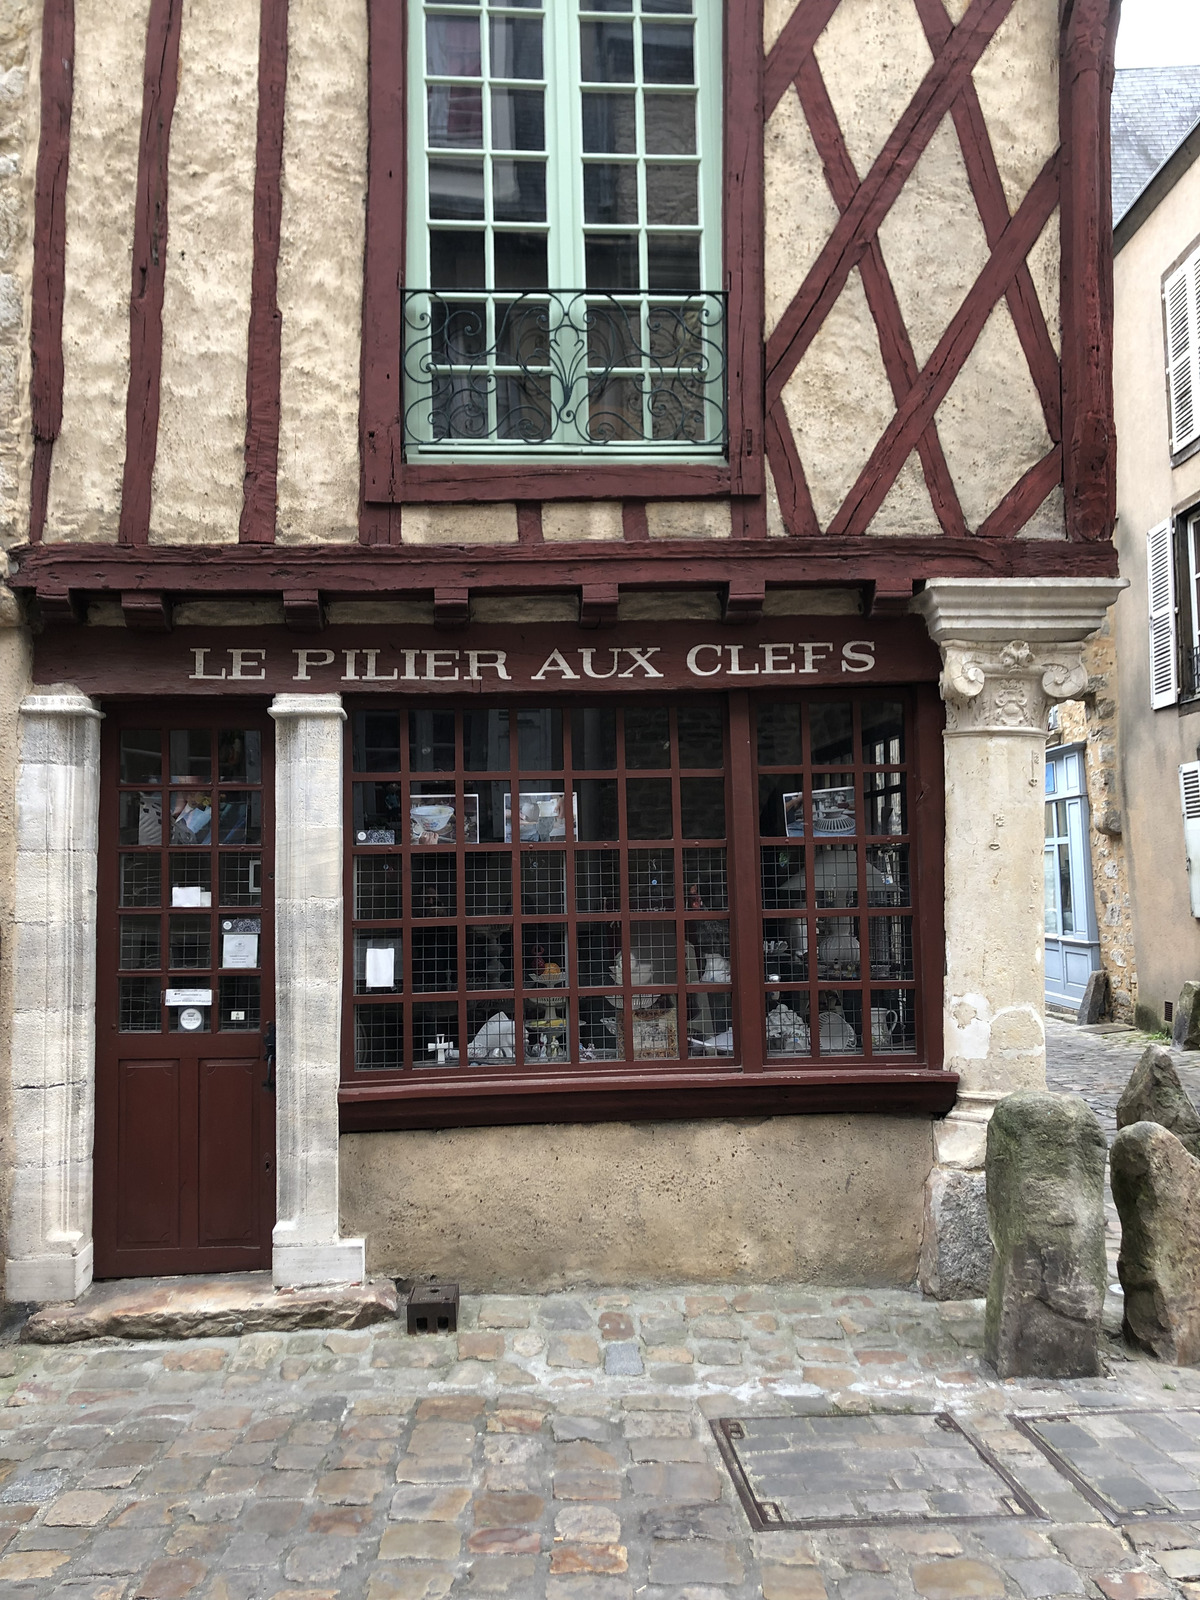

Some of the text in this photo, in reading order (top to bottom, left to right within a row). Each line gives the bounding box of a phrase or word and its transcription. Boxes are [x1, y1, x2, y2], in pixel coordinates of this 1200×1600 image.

[189, 641, 876, 681] LE PILIER AUX CLEFS
